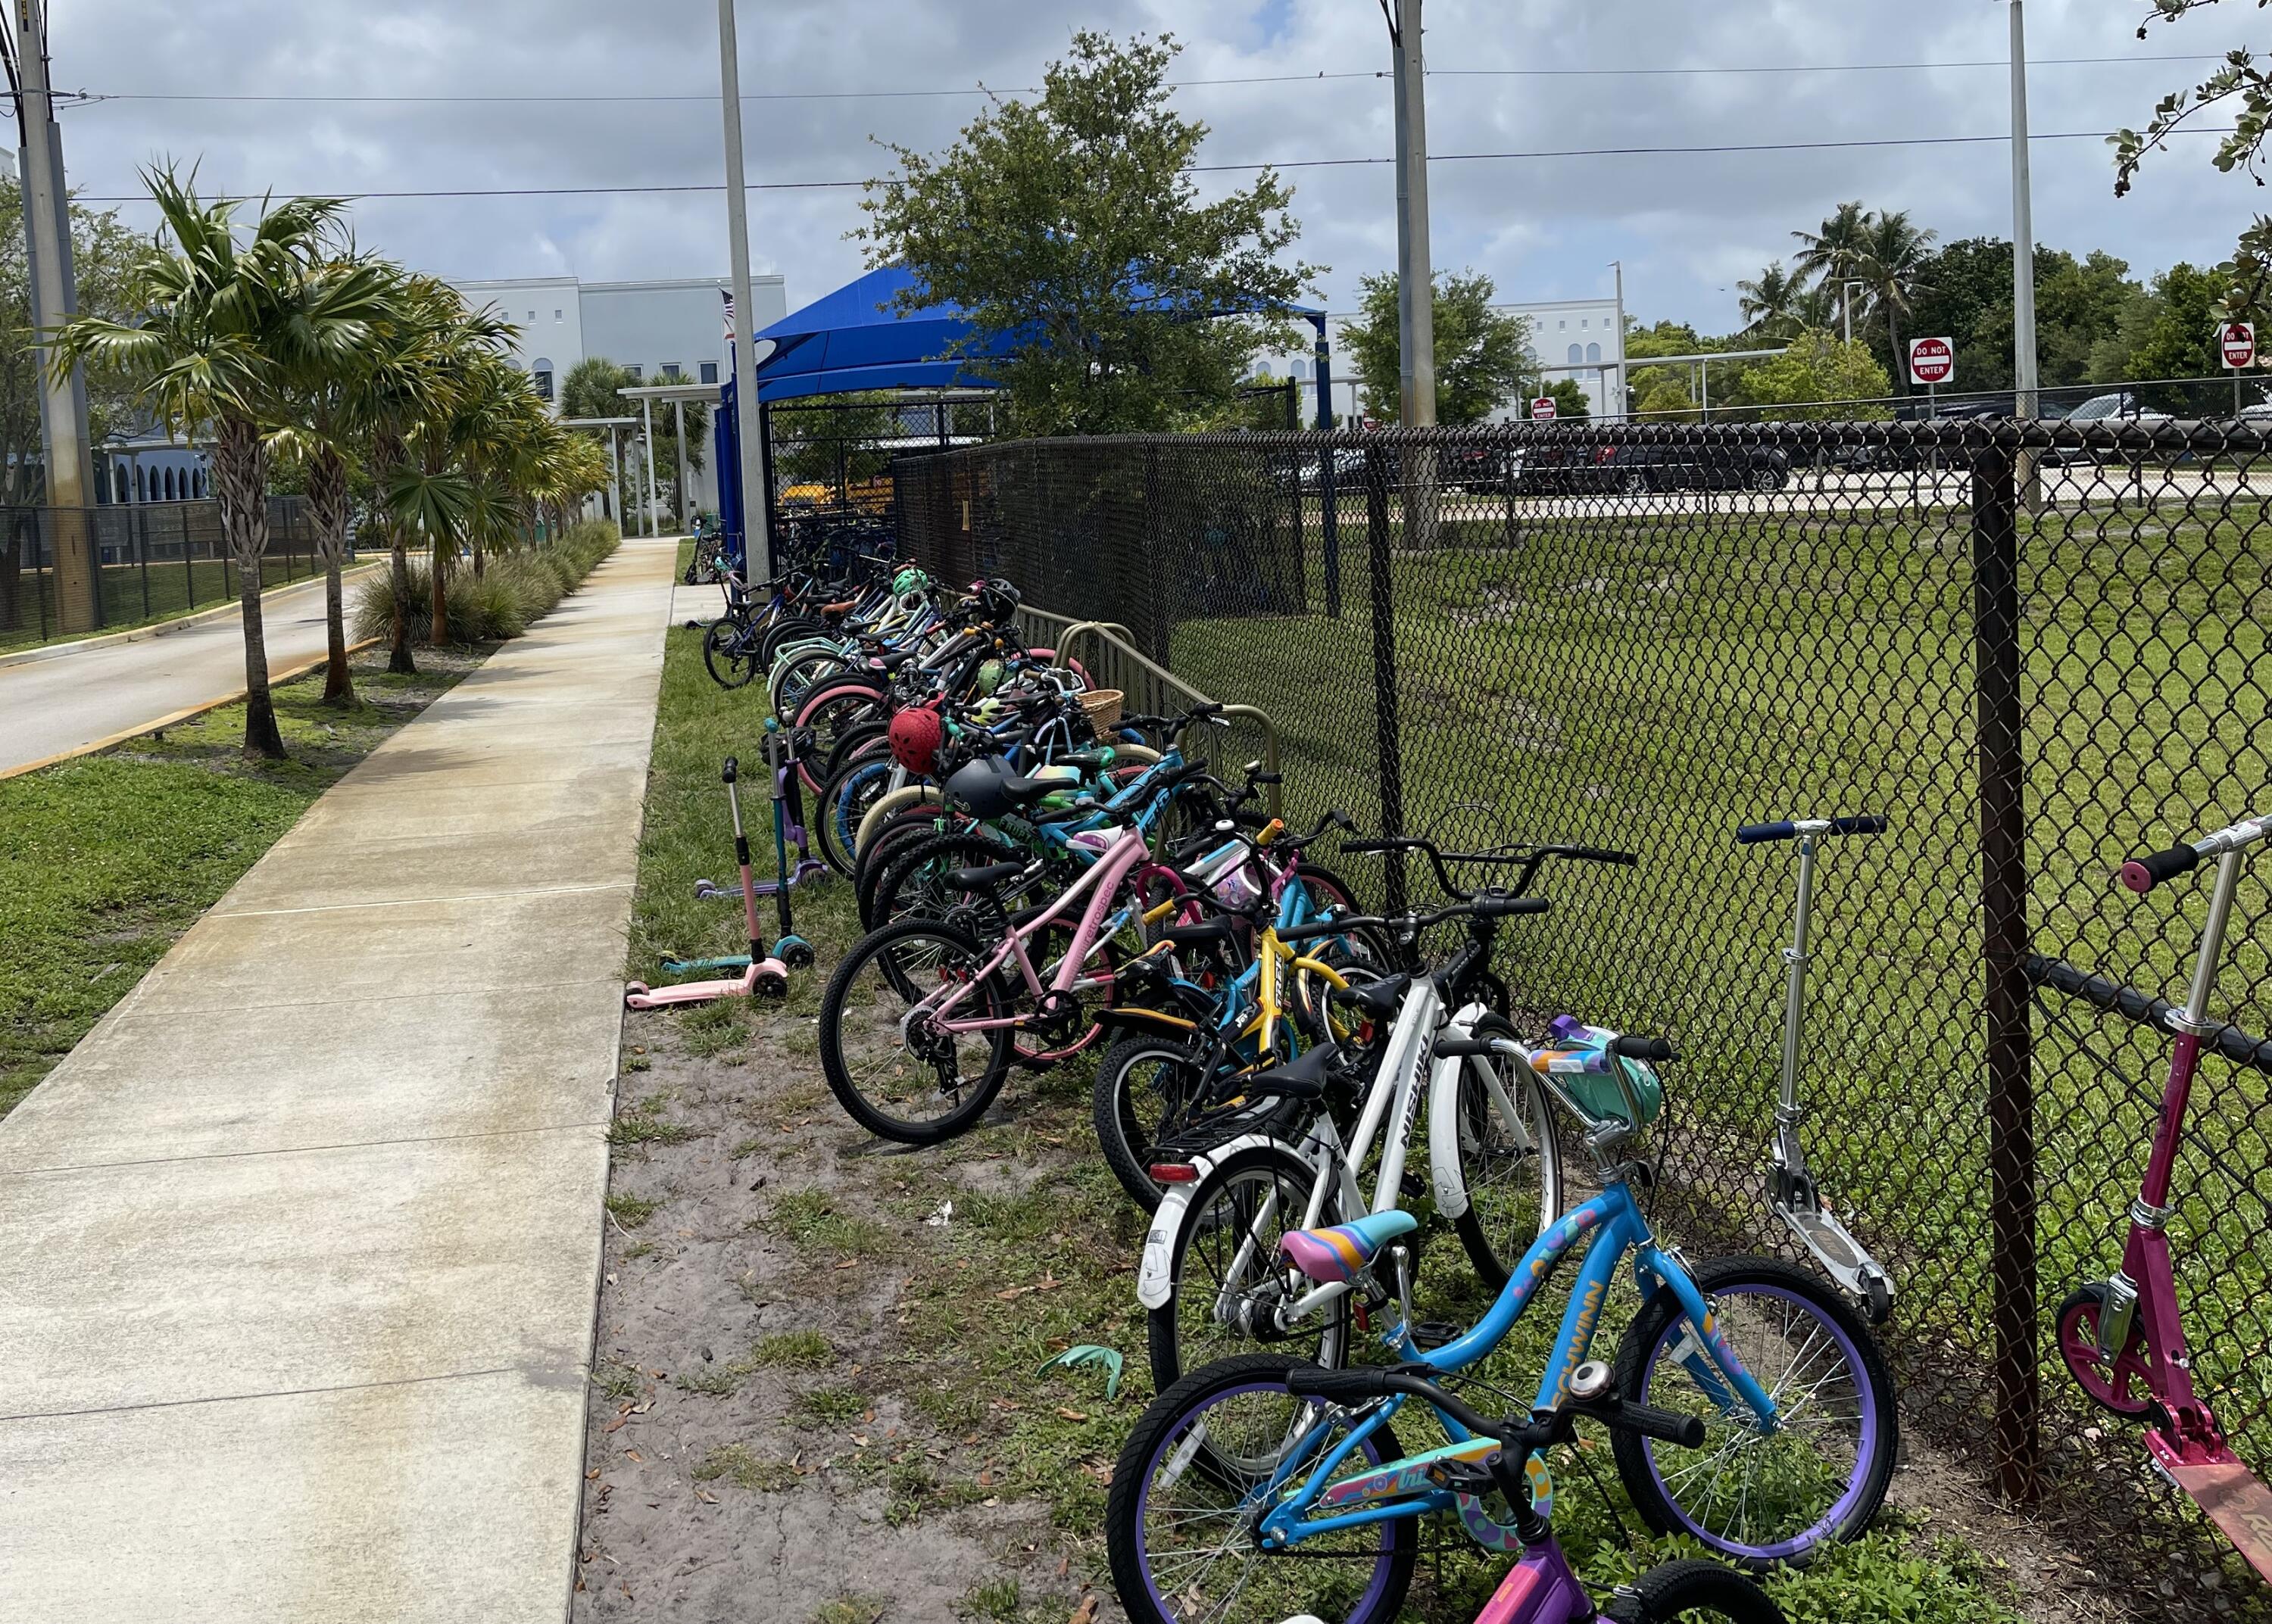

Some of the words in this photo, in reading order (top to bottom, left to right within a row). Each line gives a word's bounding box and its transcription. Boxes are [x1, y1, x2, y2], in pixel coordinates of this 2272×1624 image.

[1917, 347, 1927, 356] DO
[1930, 346, 1946, 354] NOT
[1920, 366, 1944, 375] ENTER
[1084, 881, 1115, 945] retrospec
[1400, 1033, 1428, 1150] NISHIKI
